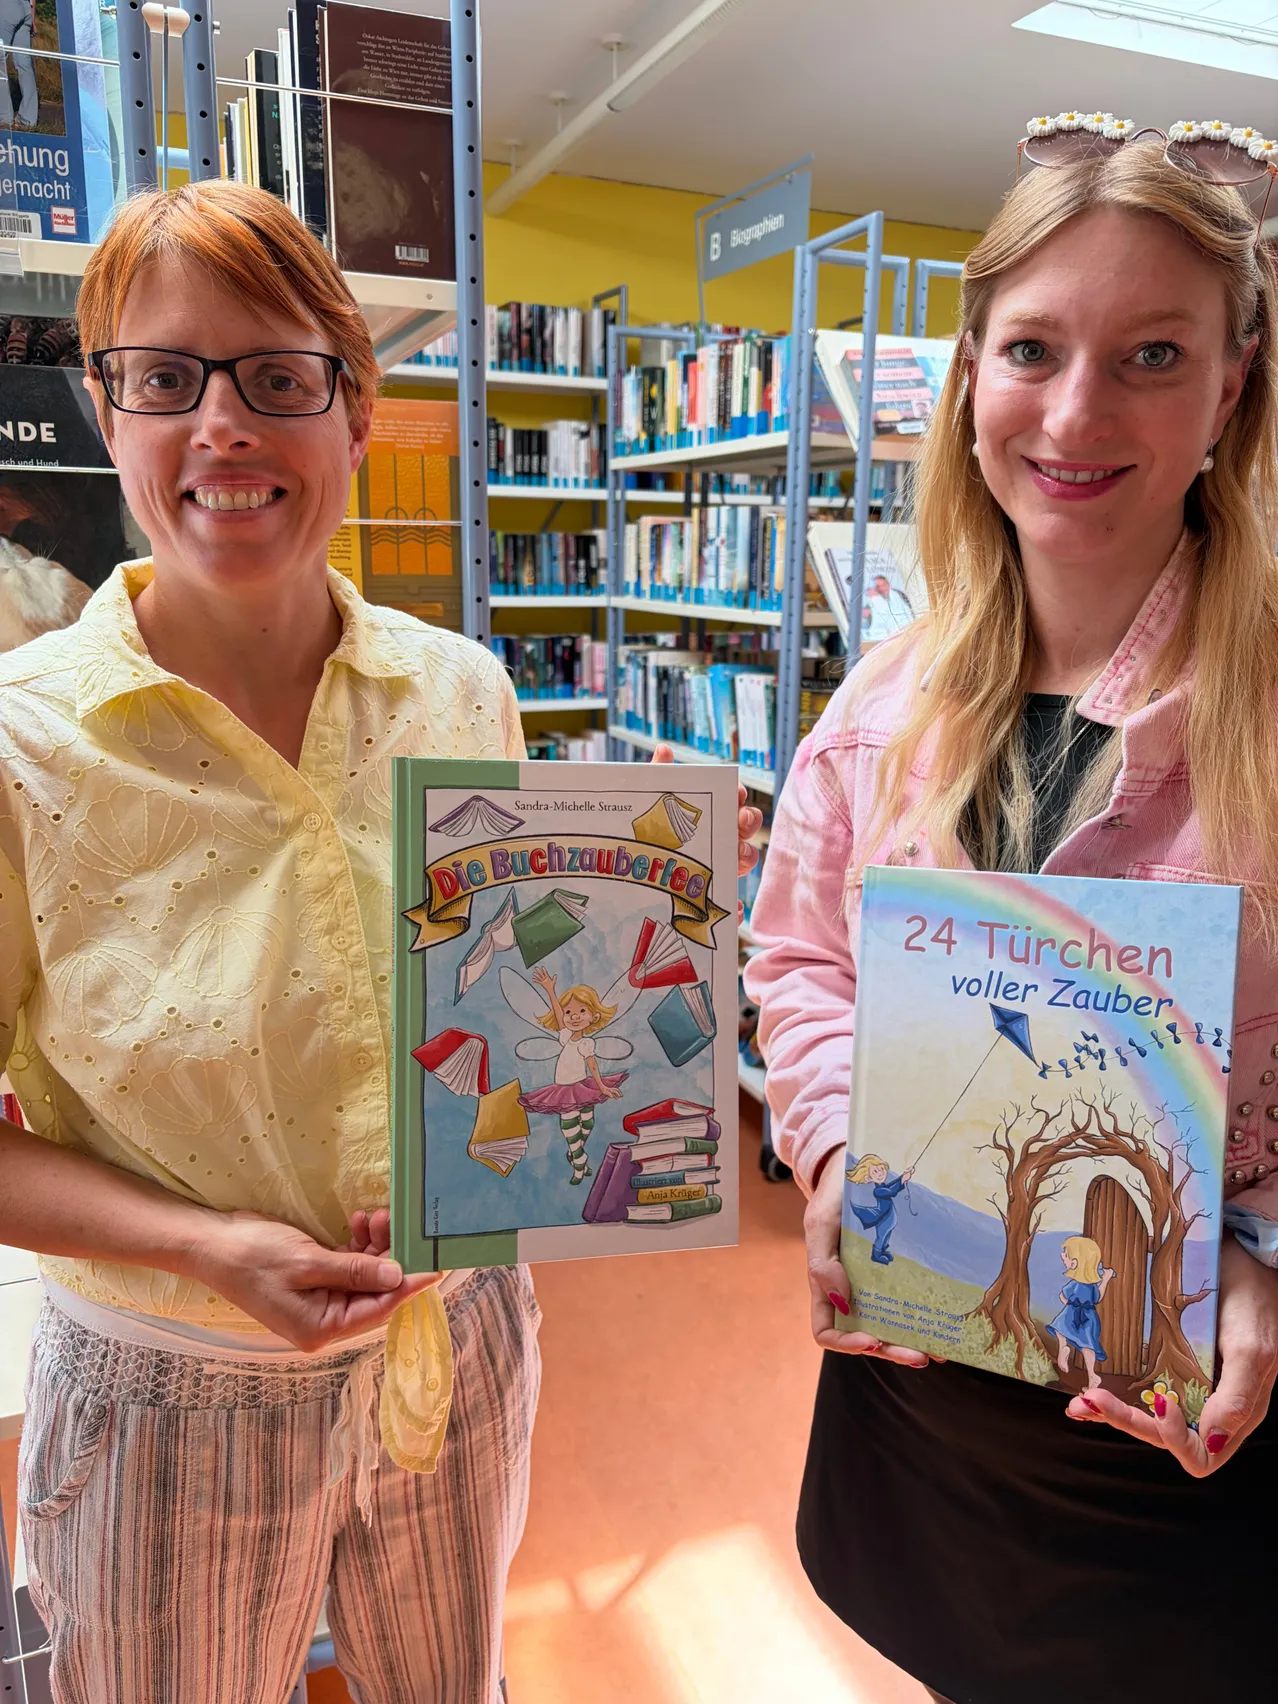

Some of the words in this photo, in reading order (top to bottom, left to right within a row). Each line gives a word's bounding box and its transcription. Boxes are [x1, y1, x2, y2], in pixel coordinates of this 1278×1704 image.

[0, 179, 70, 200] emacht
[710, 232, 721, 261] B
[730, 212, 784, 248] Biographien
[0, 421, 57, 443] NDE
[36, 459, 59, 467] Hund
[514, 800, 595, 812] Sandra-Michelle
[598, 801, 633, 812] Strausz
[433, 860, 487, 901] Die
[489, 842, 705, 899] Buchzauberfee
[904, 915, 957, 956] 24
[976, 920, 1173, 978] Türchen
[951, 970, 1038, 1002] voller
[1047, 978, 1173, 1018] Zauber
[647, 1190, 668, 1200] Anja
[670, 1188, 701, 1200] Krüger
[858, 1288, 871, 1298] Von
[853, 1298, 900, 1317] Illustrationen
[902, 1312, 915, 1321] von
[917, 1315, 935, 1327] Anja
[917, 1328, 931, 1336] und
[932, 1330, 961, 1344] Kindern
